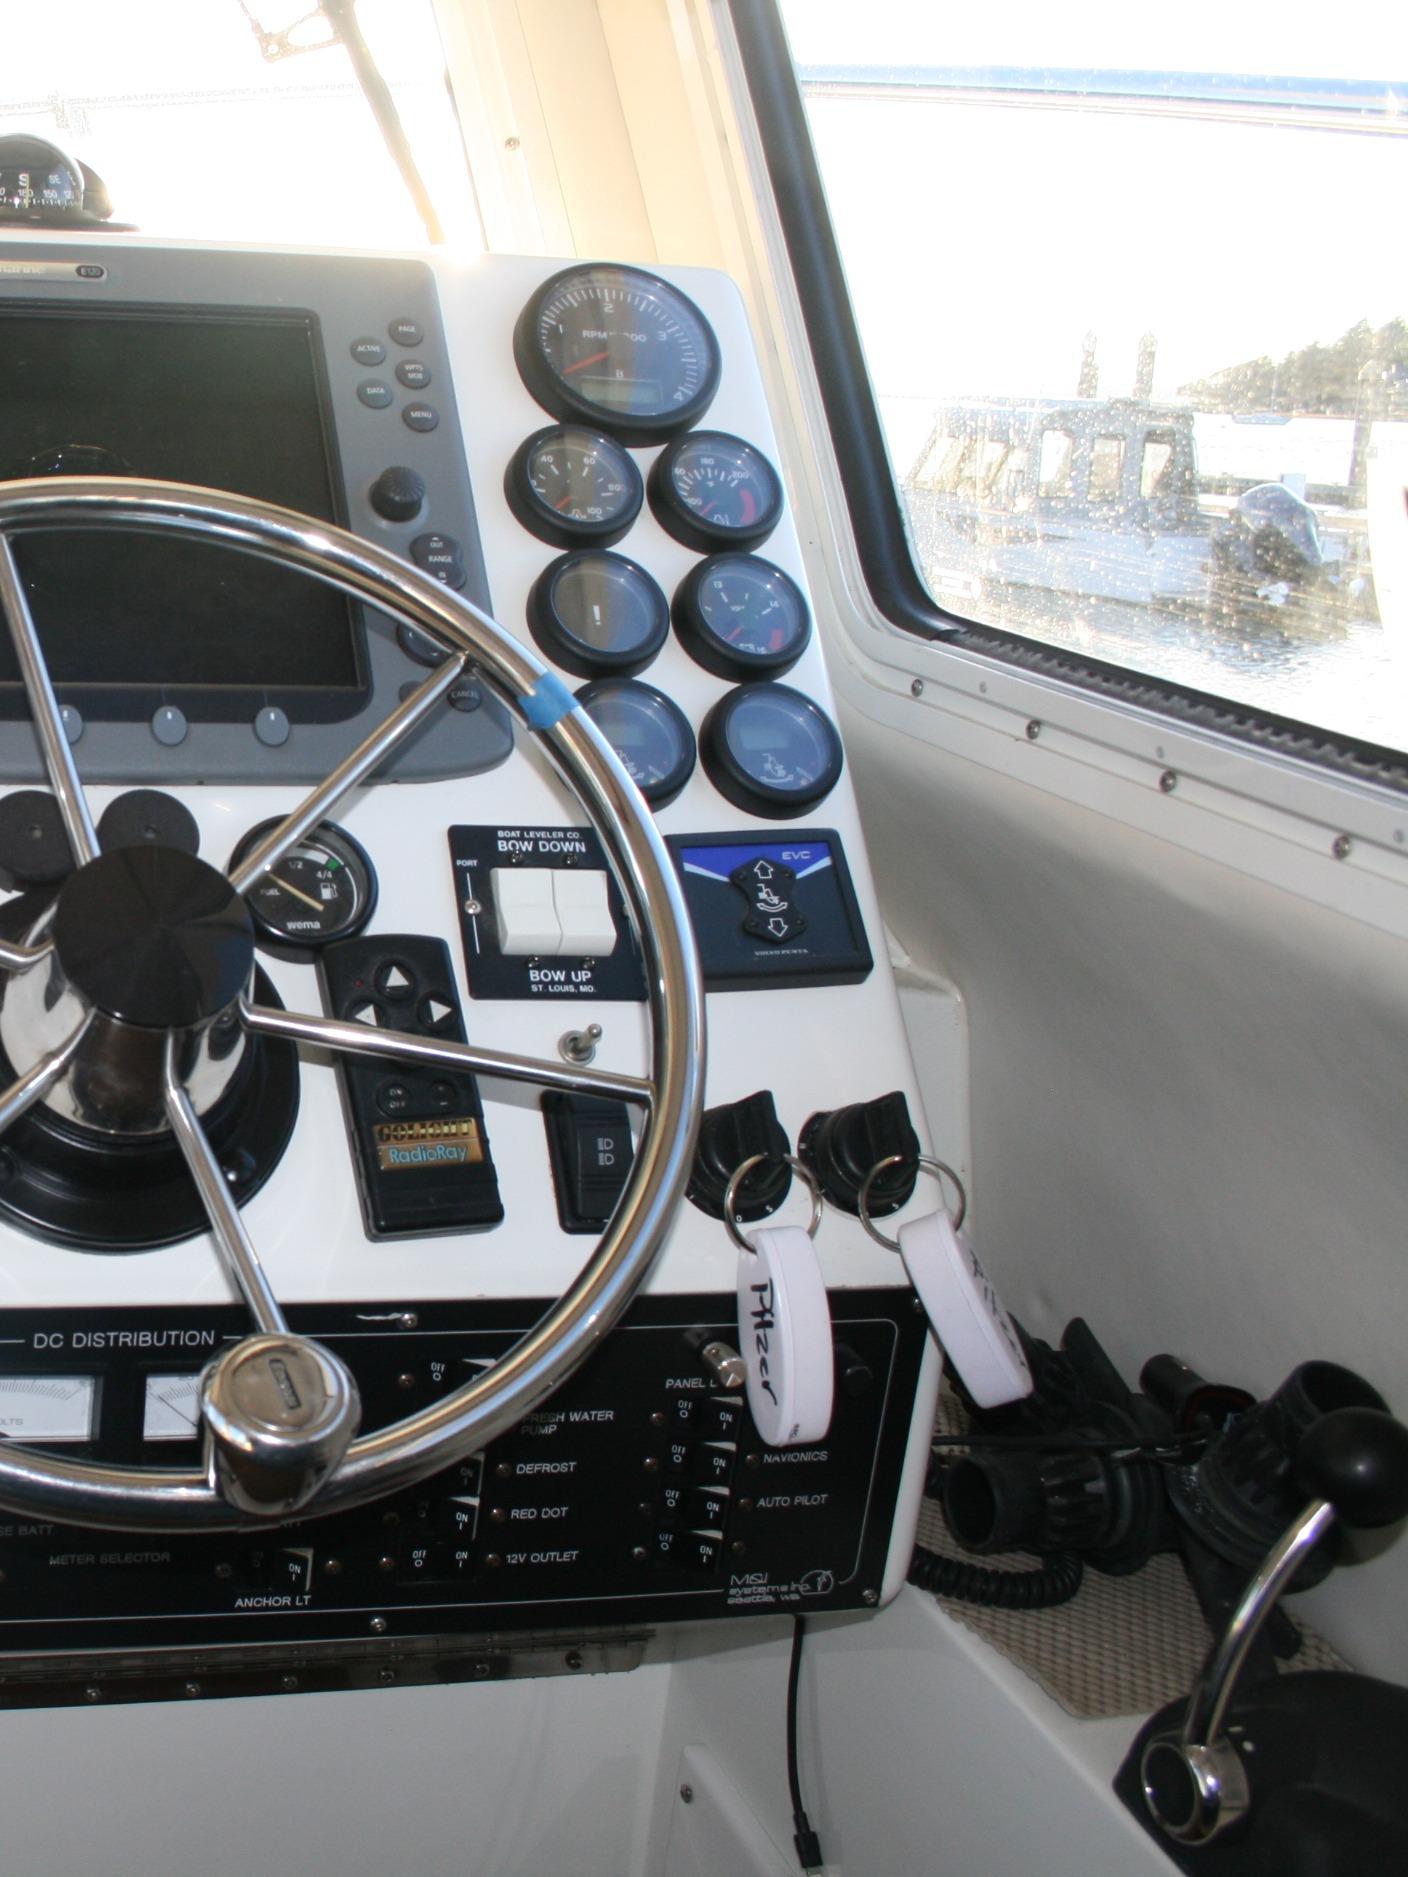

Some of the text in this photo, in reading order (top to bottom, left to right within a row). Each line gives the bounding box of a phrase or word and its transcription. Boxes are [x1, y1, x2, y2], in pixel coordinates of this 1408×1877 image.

[19, 173, 29, 186] S
[49, 174, 61, 184] SE
[18, 189, 33, 197] 180
[43, 190, 57, 198] 150
[604, 303, 614, 312] 2
[398, 325, 416, 333] PAGE
[583, 330, 608, 338] RPM
[658, 331, 666, 340] 3
[357, 345, 381, 353] ACTIVE
[367, 387, 385, 395] DATA
[411, 411, 432, 419] MENU
[541, 455, 553, 463] 40
[584, 457, 595, 465] 60
[587, 506, 601, 515] 100
[428, 555, 452, 563] RANGE
[497, 841, 586, 853] BOW DOWN
[782, 852, 810, 860] EVC
[530, 970, 592, 983] BOW UP
[378, 1119, 473, 1143] GOLIGHT
[389, 1144, 467, 1163] RadioRay
[34, 1331, 214, 1349] DC DISTRIBUTION
[431, 1362, 444, 1372] OFF
[666, 1379, 705, 1388] PANEL
[678, 1400, 692, 1409] OFF
[570, 1411, 614, 1421] WATER
[720, 1412, 732, 1422] ON
[672, 1445, 685, 1454] OFF
[764, 1451, 828, 1463] NAVIONICS
[714, 1458, 726, 1467] ON
[516, 1462, 576, 1474] DEFROST
[666, 1490, 679, 1499] OFF
[757, 1495, 828, 1508] AUTO PILOT
[707, 1502, 719, 1512] ON
[456, 1513, 468, 1522] ON
[511, 1508, 568, 1519] RED DOT
[18, 1525, 54, 1536] BATT
[659, 1534, 673, 1543] OFF
[413, 1550, 426, 1558] OFF
[700, 1546, 712, 1555] ON
[49, 1552, 170, 1566] METER SELECTOR
[456, 1551, 468, 1560] ON
[506, 1551, 578, 1564] 12V OUTLET
[288, 1564, 301, 1574] ON
[235, 1595, 310, 1608] ANCHOR LT
